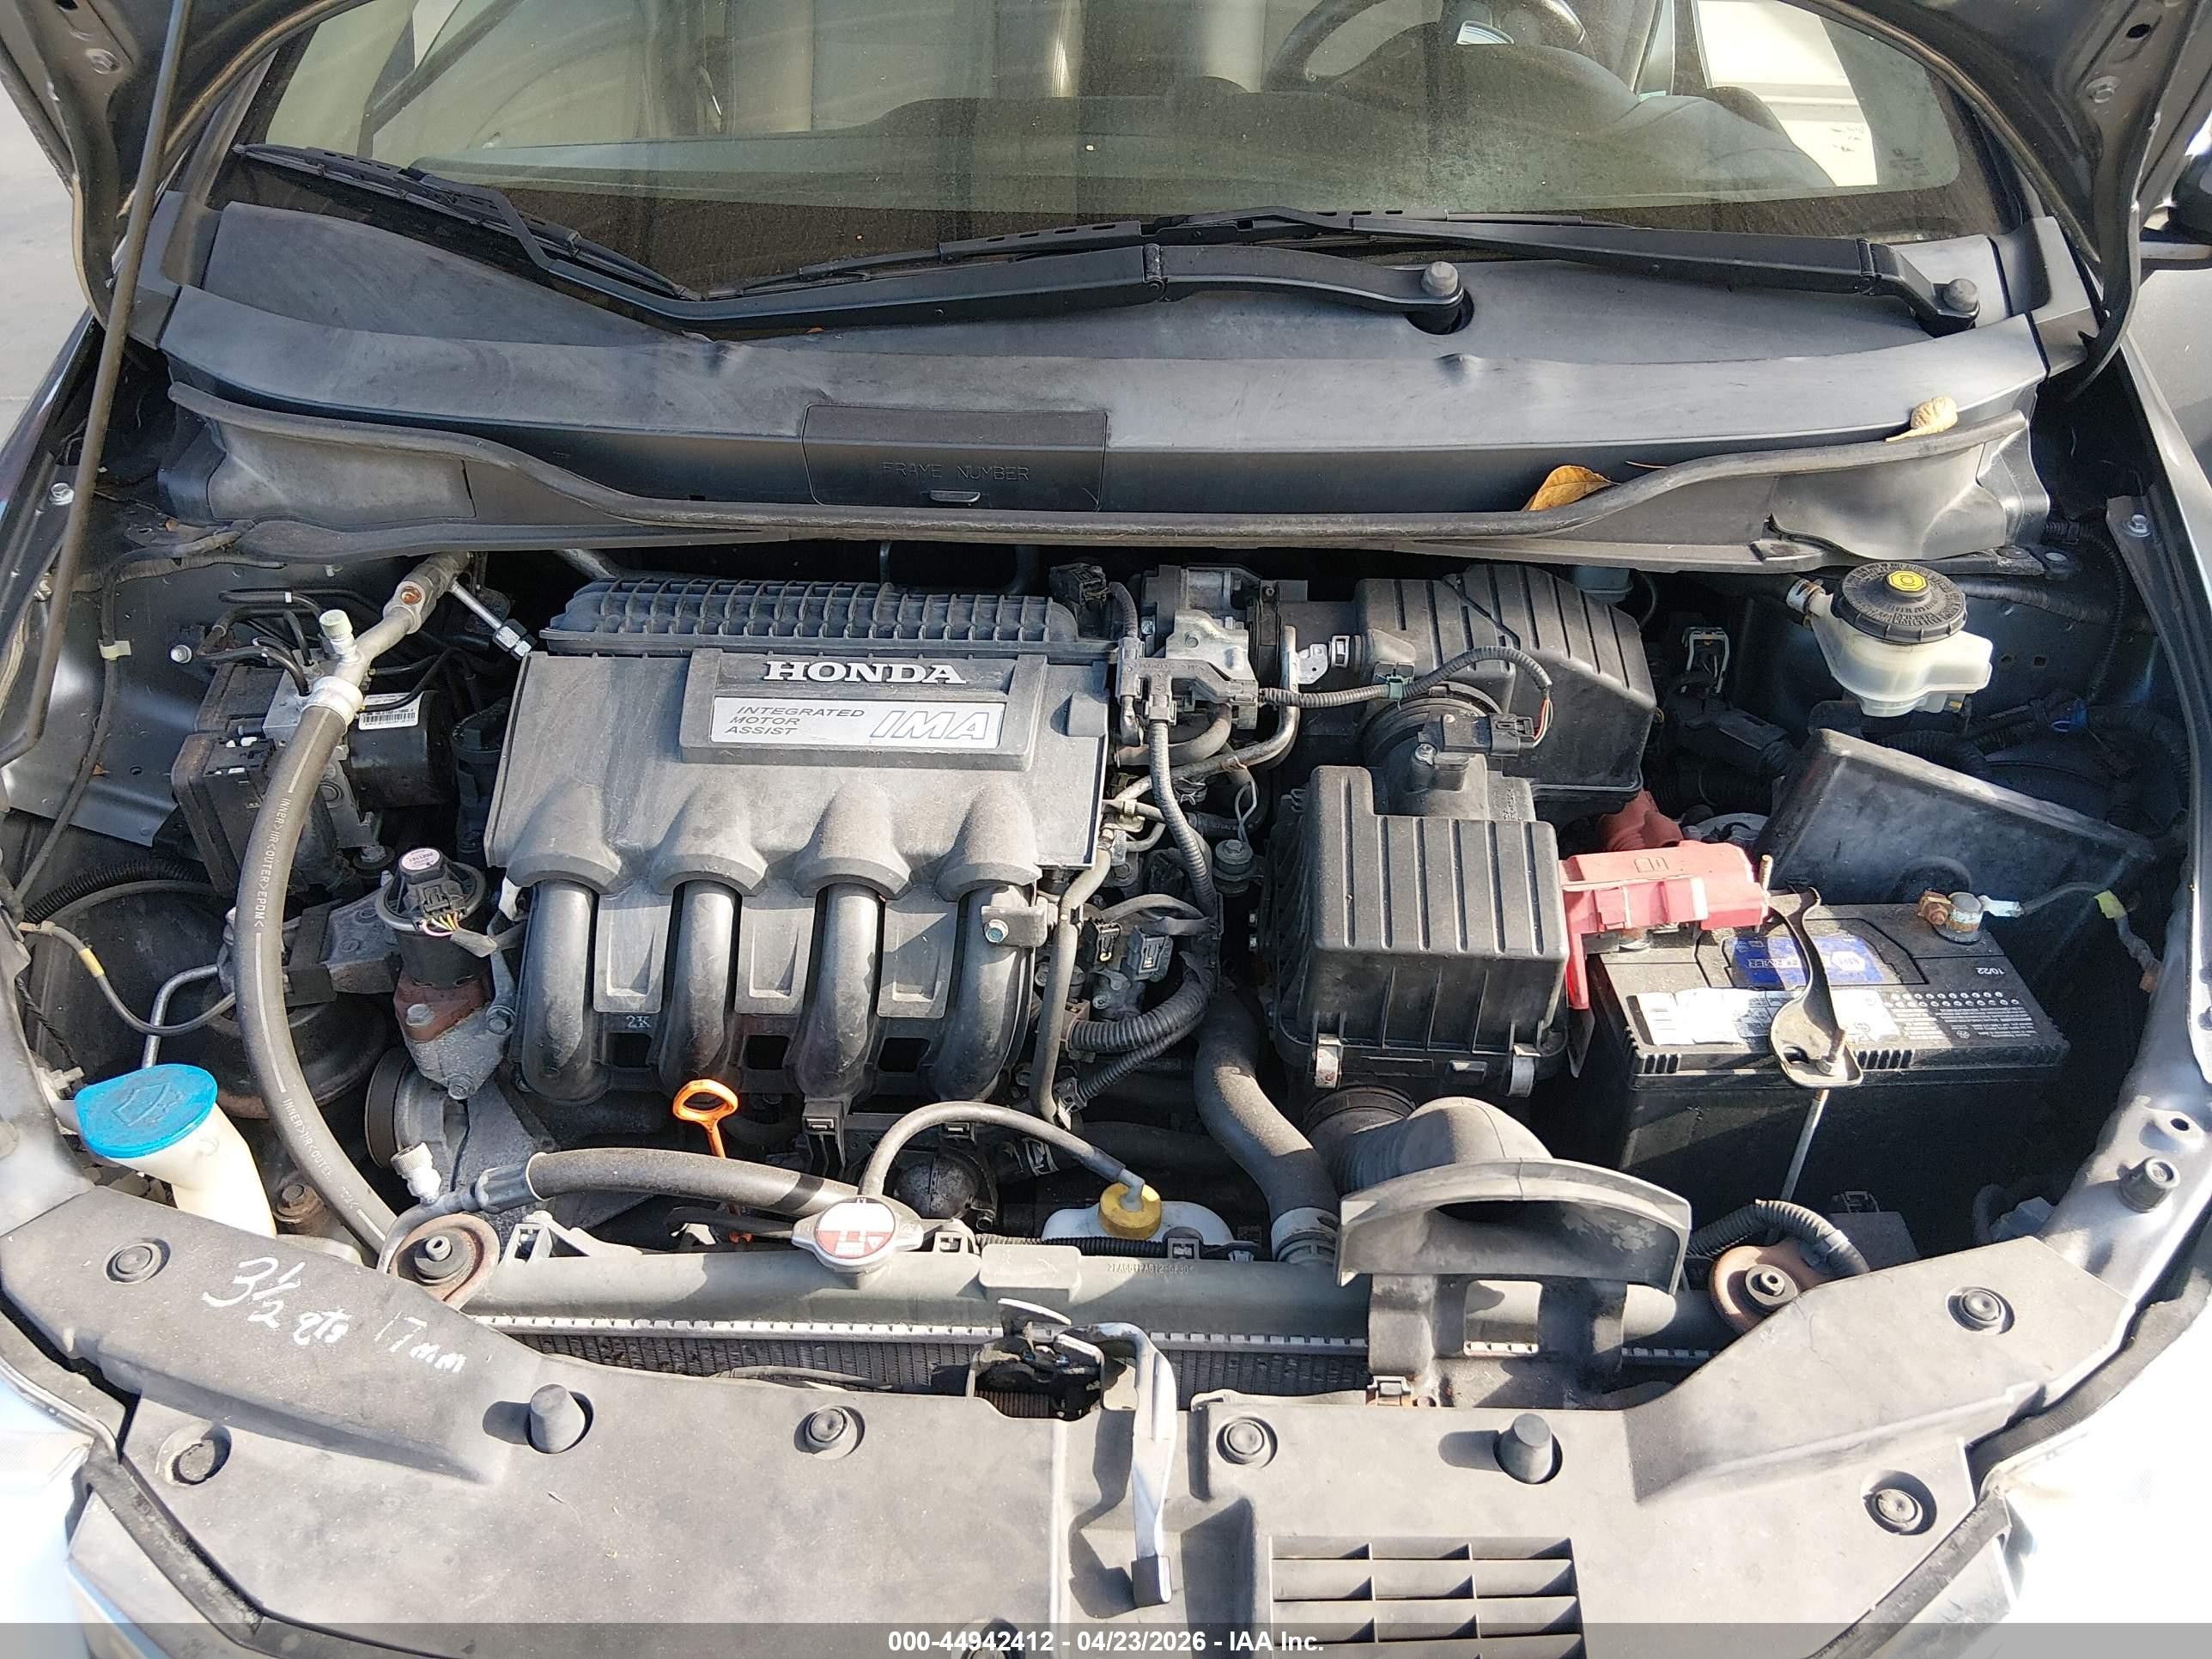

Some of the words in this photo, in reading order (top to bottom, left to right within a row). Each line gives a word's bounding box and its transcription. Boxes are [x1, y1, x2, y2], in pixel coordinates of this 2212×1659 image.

[883, 462, 942, 477] FRAME
[957, 465, 1030, 481] NUMBER
[763, 660, 966, 684] HONDA
[736, 706, 865, 717] INTEGRATED
[729, 716, 800, 726] MOTOR
[869, 710, 990, 740] IMA
[725, 726, 799, 736] ASSIST
[1976, 967, 2006, 976] 10/22
[625, 1015, 652, 1029] 2K
